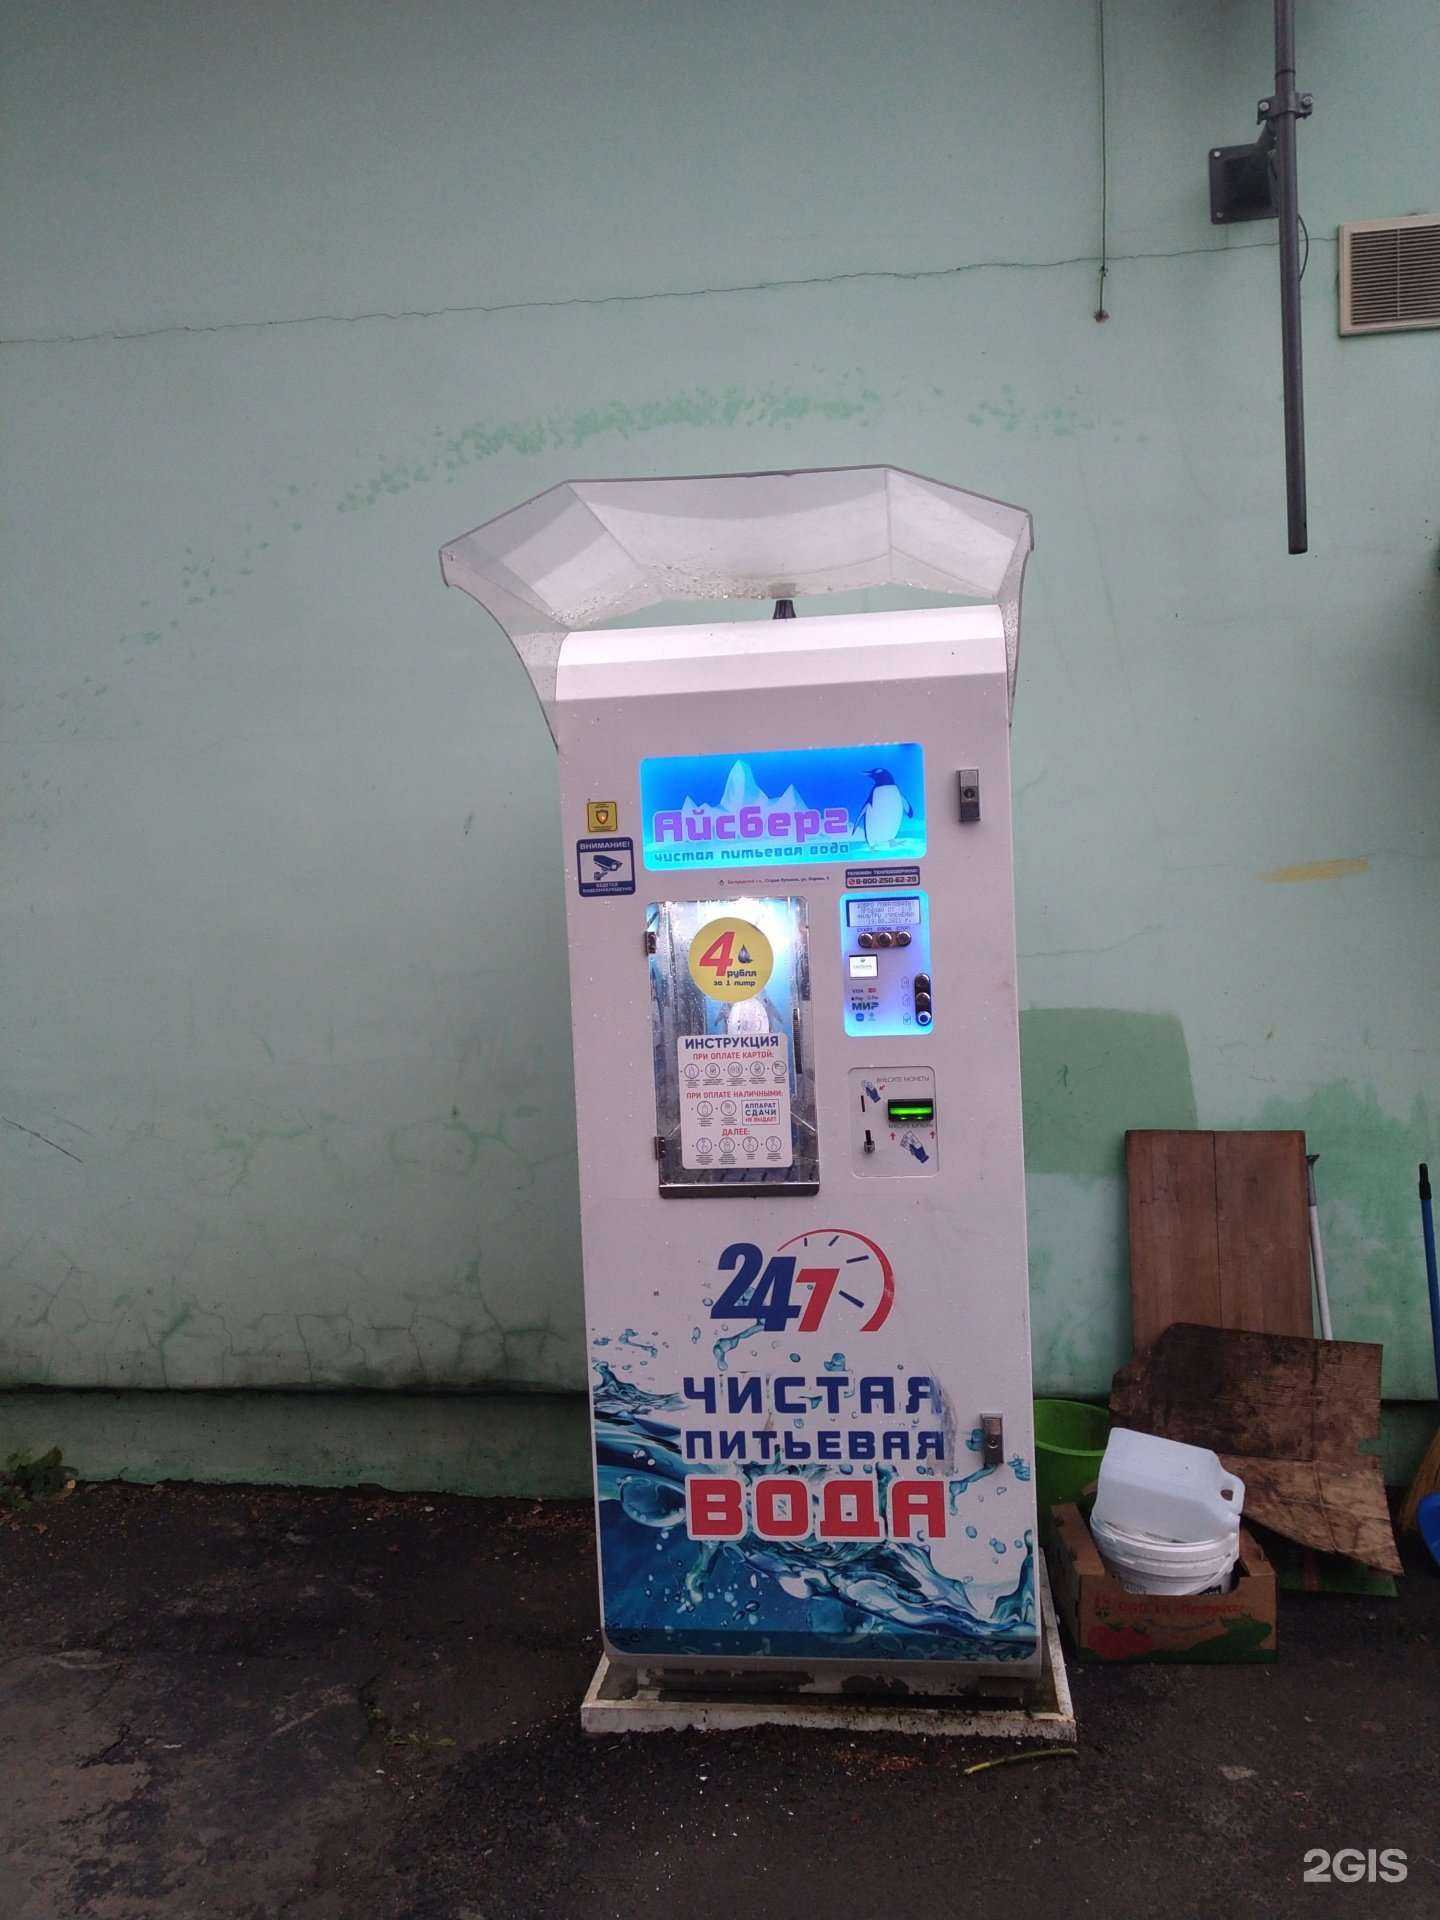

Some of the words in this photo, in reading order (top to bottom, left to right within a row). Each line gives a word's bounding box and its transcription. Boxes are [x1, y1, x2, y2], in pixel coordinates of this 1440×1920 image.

[654, 806, 848, 842] Айсберг
[580, 841, 630, 850] ВНИМАНИЕ!
[655, 851, 714, 862] чистая
[721, 846, 802, 860] питьевая
[810, 842, 849, 855] вода
[699, 931, 736, 976] 4
[727, 969, 757, 978] рубля
[852, 1002, 879, 1010] МИР
[685, 1036, 778, 1049] ИНСТРУКЦИЯ
[711, 1051, 740, 1059] ОПЛАТЕ
[687, 1091, 701, 1099] ПРИ
[704, 1090, 731, 1098] ОПЛАТЕ
[683, 1376, 942, 1414] ЧИСТАЯ
[685, 1430, 945, 1460] ПИТЬЕВАЯ
[690, 1479, 946, 1538] ВОДА
